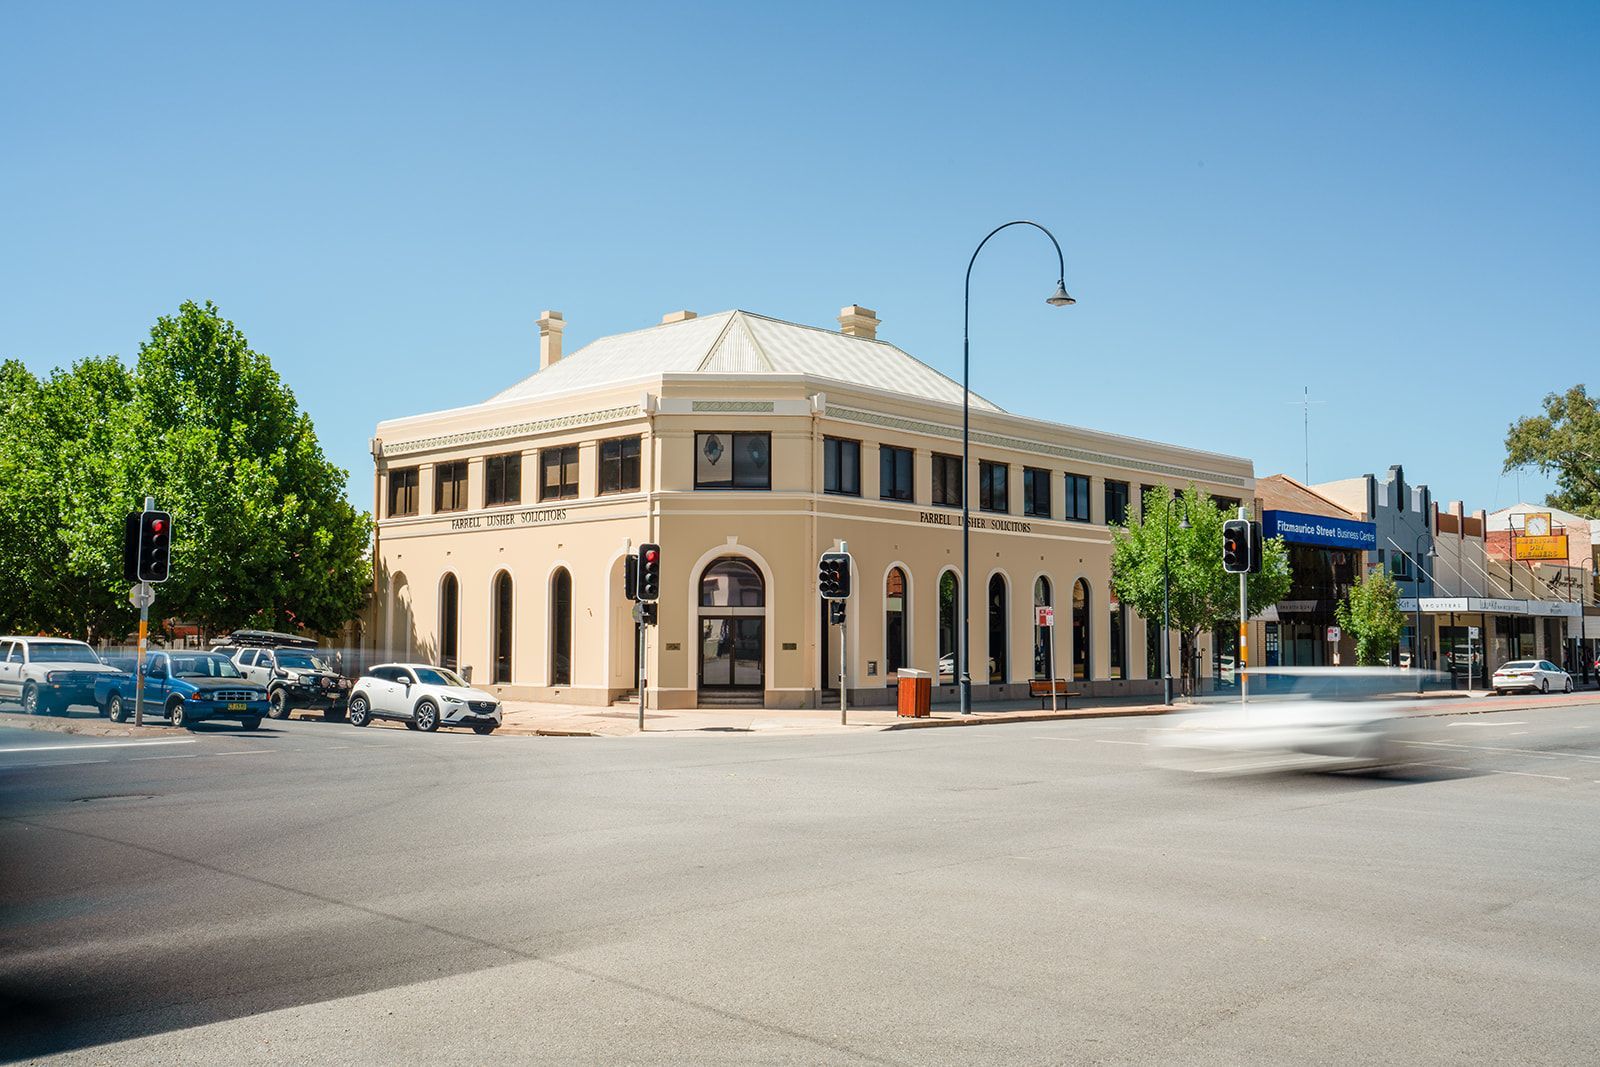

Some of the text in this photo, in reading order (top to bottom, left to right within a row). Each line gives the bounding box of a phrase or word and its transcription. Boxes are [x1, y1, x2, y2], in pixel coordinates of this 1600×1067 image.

[451, 508, 567, 530] FARRELL LUSHER SOLICITORS
[920, 512, 1031, 533] FARRELL LSHER SOLICITORS
[1277, 520, 1375, 542] Fitzmaurice Street Business Centre
